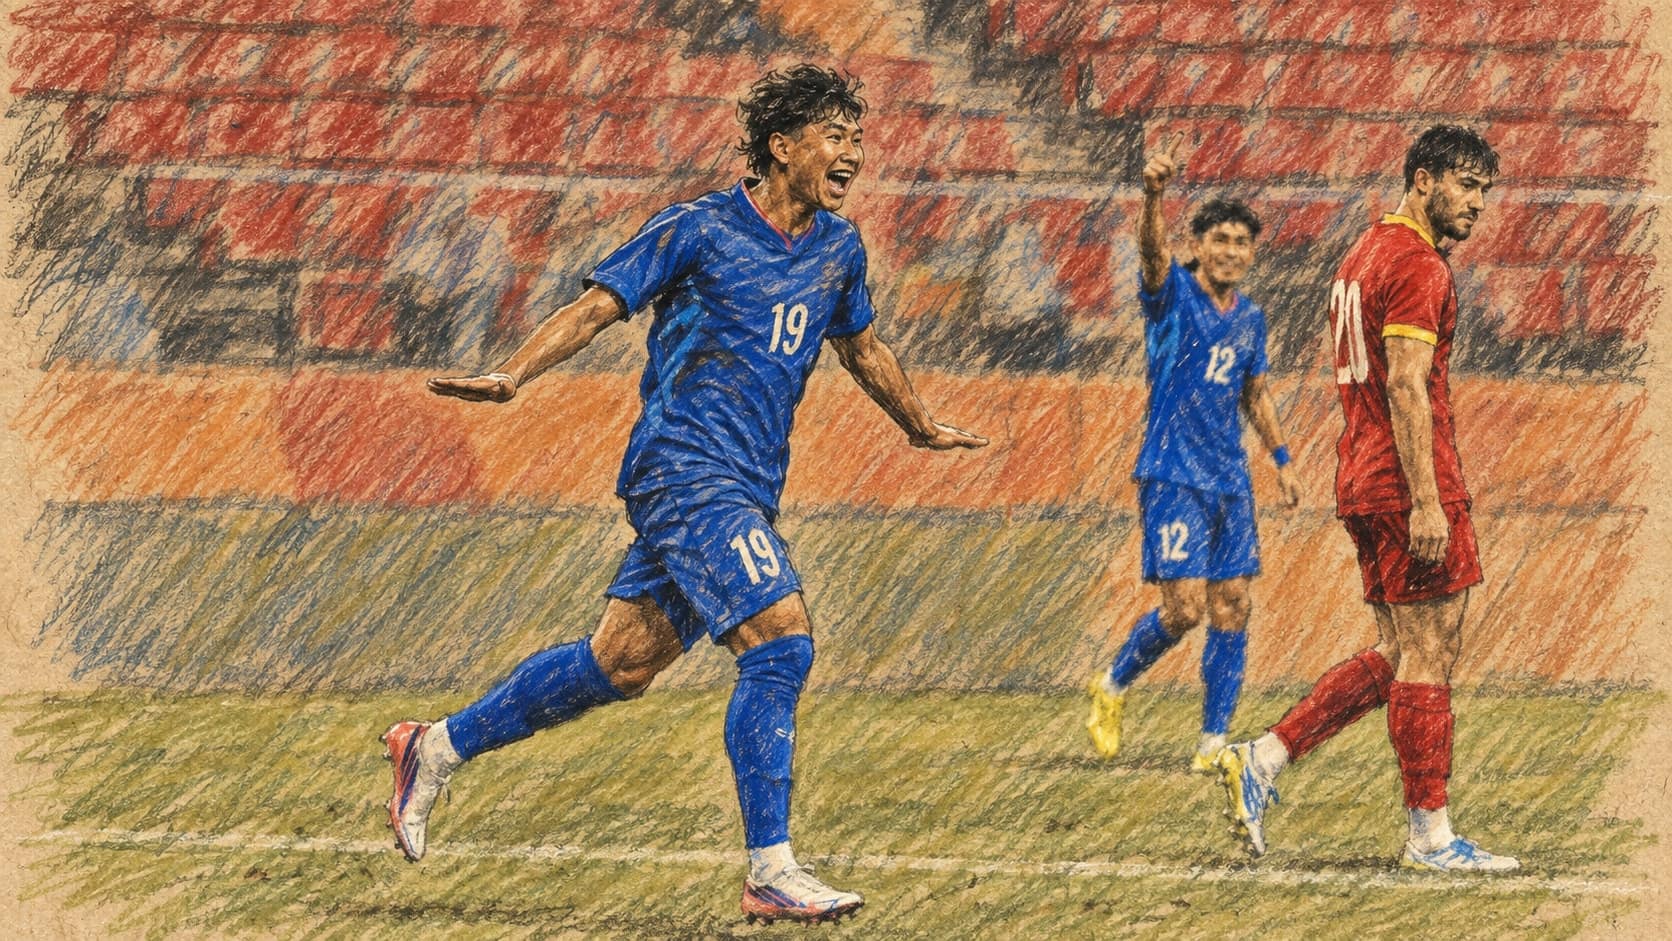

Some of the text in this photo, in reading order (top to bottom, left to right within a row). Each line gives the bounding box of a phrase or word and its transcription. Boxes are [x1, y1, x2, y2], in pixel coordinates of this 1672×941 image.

[769, 302, 809, 355] 19
[1330, 279, 1369, 385] 20
[1203, 343, 1236, 385] 12
[730, 528, 780, 585] 19
[1157, 519, 1189, 561] 12
